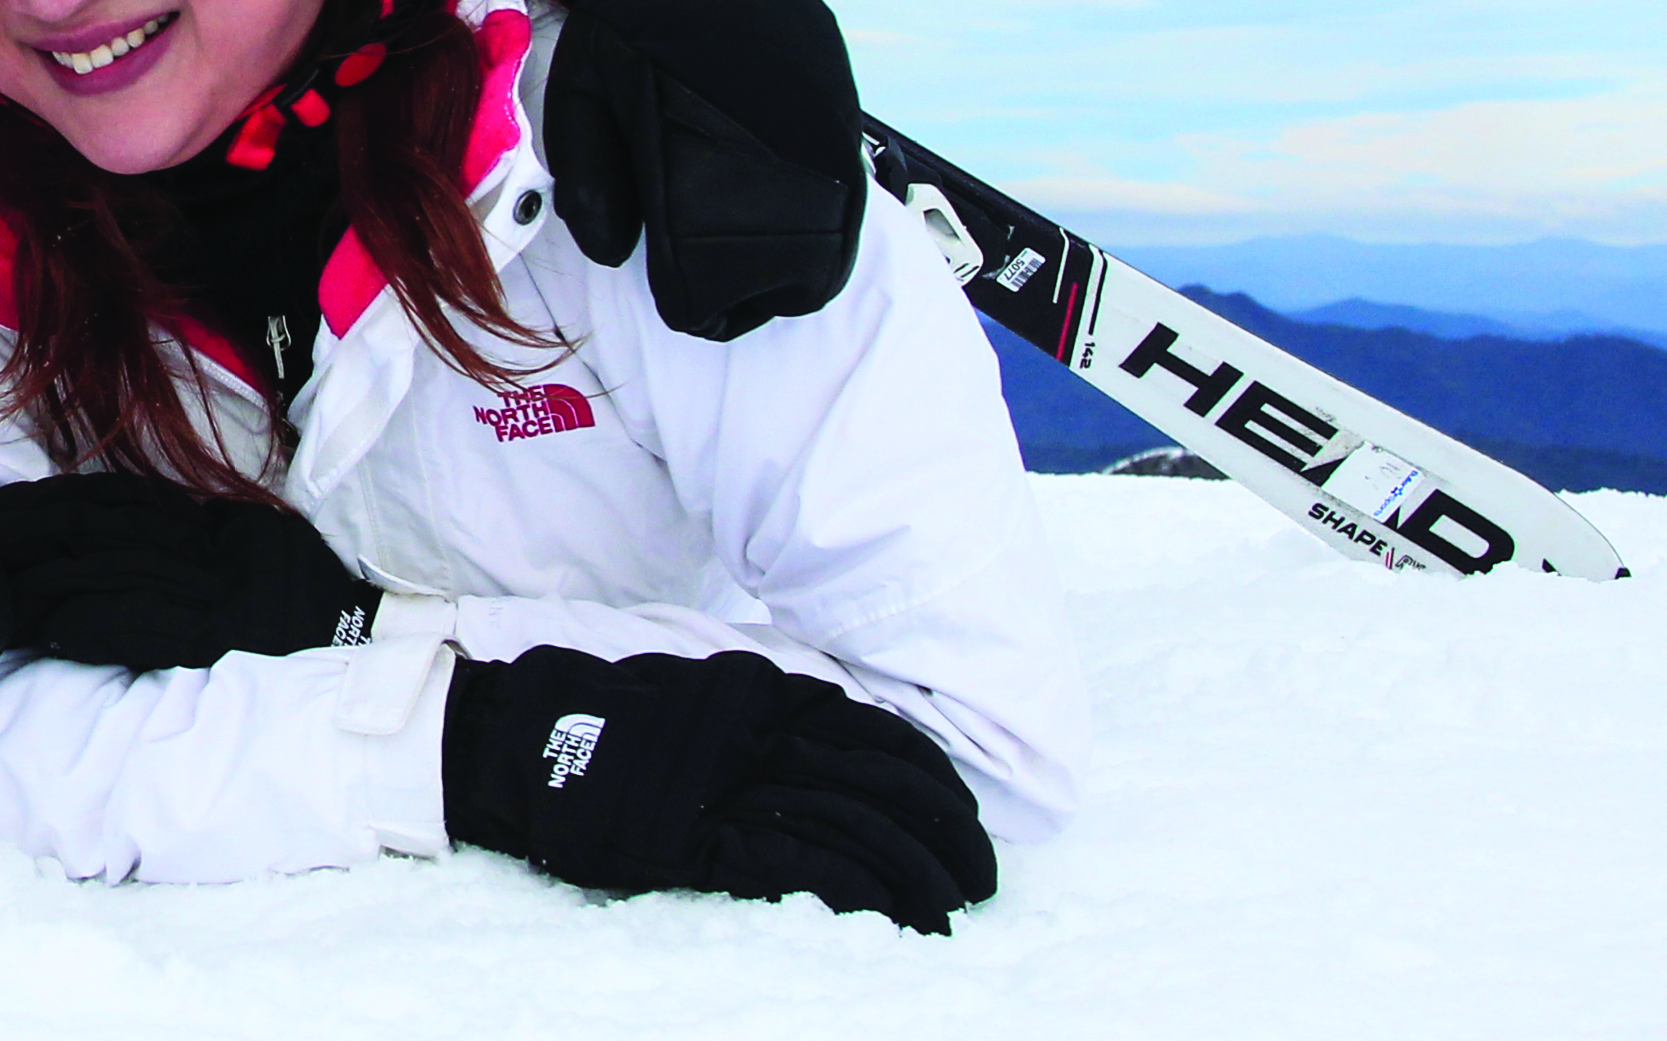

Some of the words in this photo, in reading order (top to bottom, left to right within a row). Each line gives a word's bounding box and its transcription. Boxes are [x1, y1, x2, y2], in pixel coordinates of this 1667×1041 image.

[1004, 258, 1025, 281] 5077
[1080, 342, 1096, 369] 142
[497, 385, 542, 408] THE
[473, 400, 550, 426] NORTH
[495, 416, 553, 442] FACE
[1308, 503, 1388, 556] SHAPE
[344, 605, 366, 646] NORT
[542, 729, 567, 758] THE
[570, 739, 596, 776] FACE
[547, 734, 582, 789] NORTH
